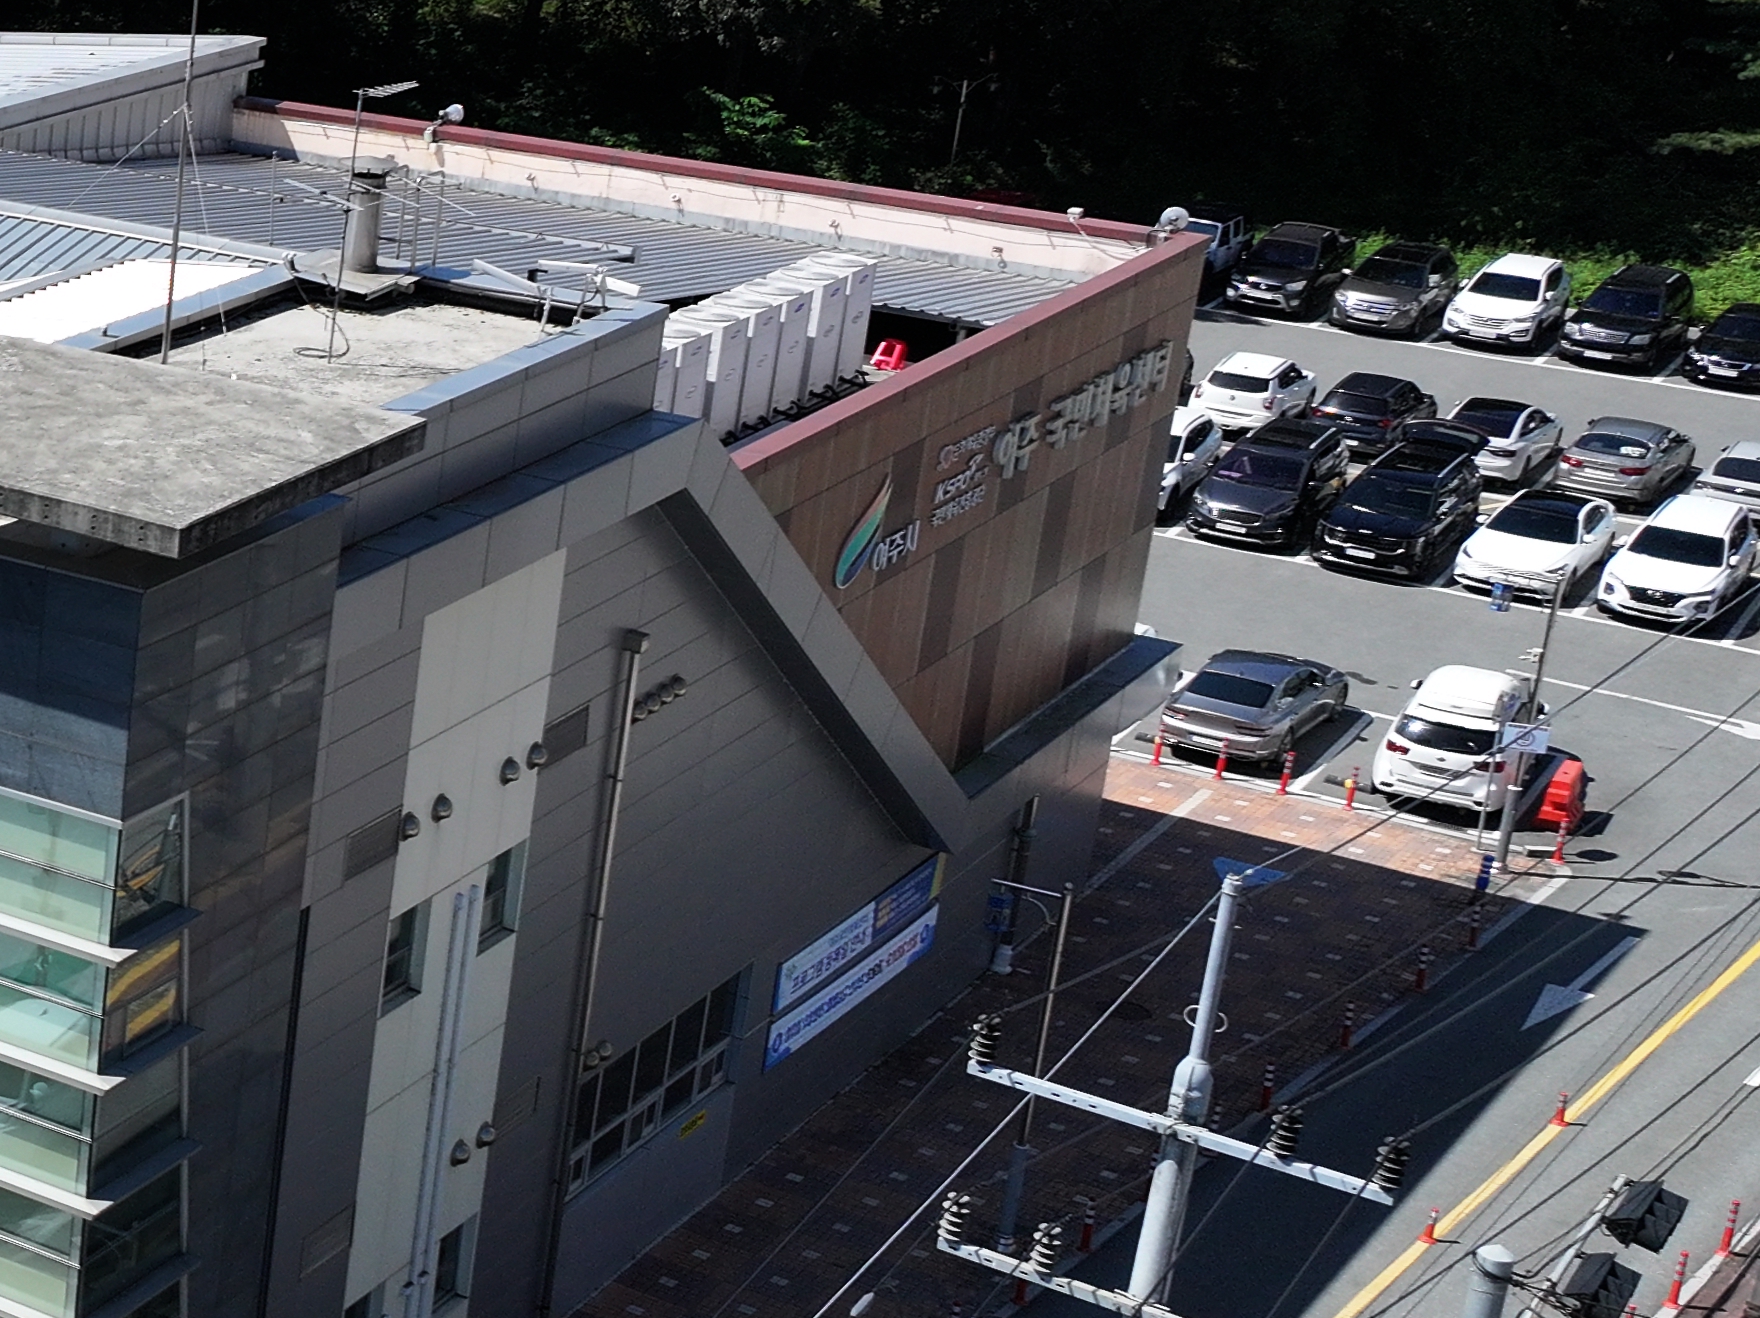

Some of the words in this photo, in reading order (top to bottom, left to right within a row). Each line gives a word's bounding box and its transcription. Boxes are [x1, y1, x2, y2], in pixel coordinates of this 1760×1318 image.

[993, 414, 1042, 479] 여주
[1046, 340, 1173, 449] 국민체육센터
[872, 520, 920, 571] 여주시
